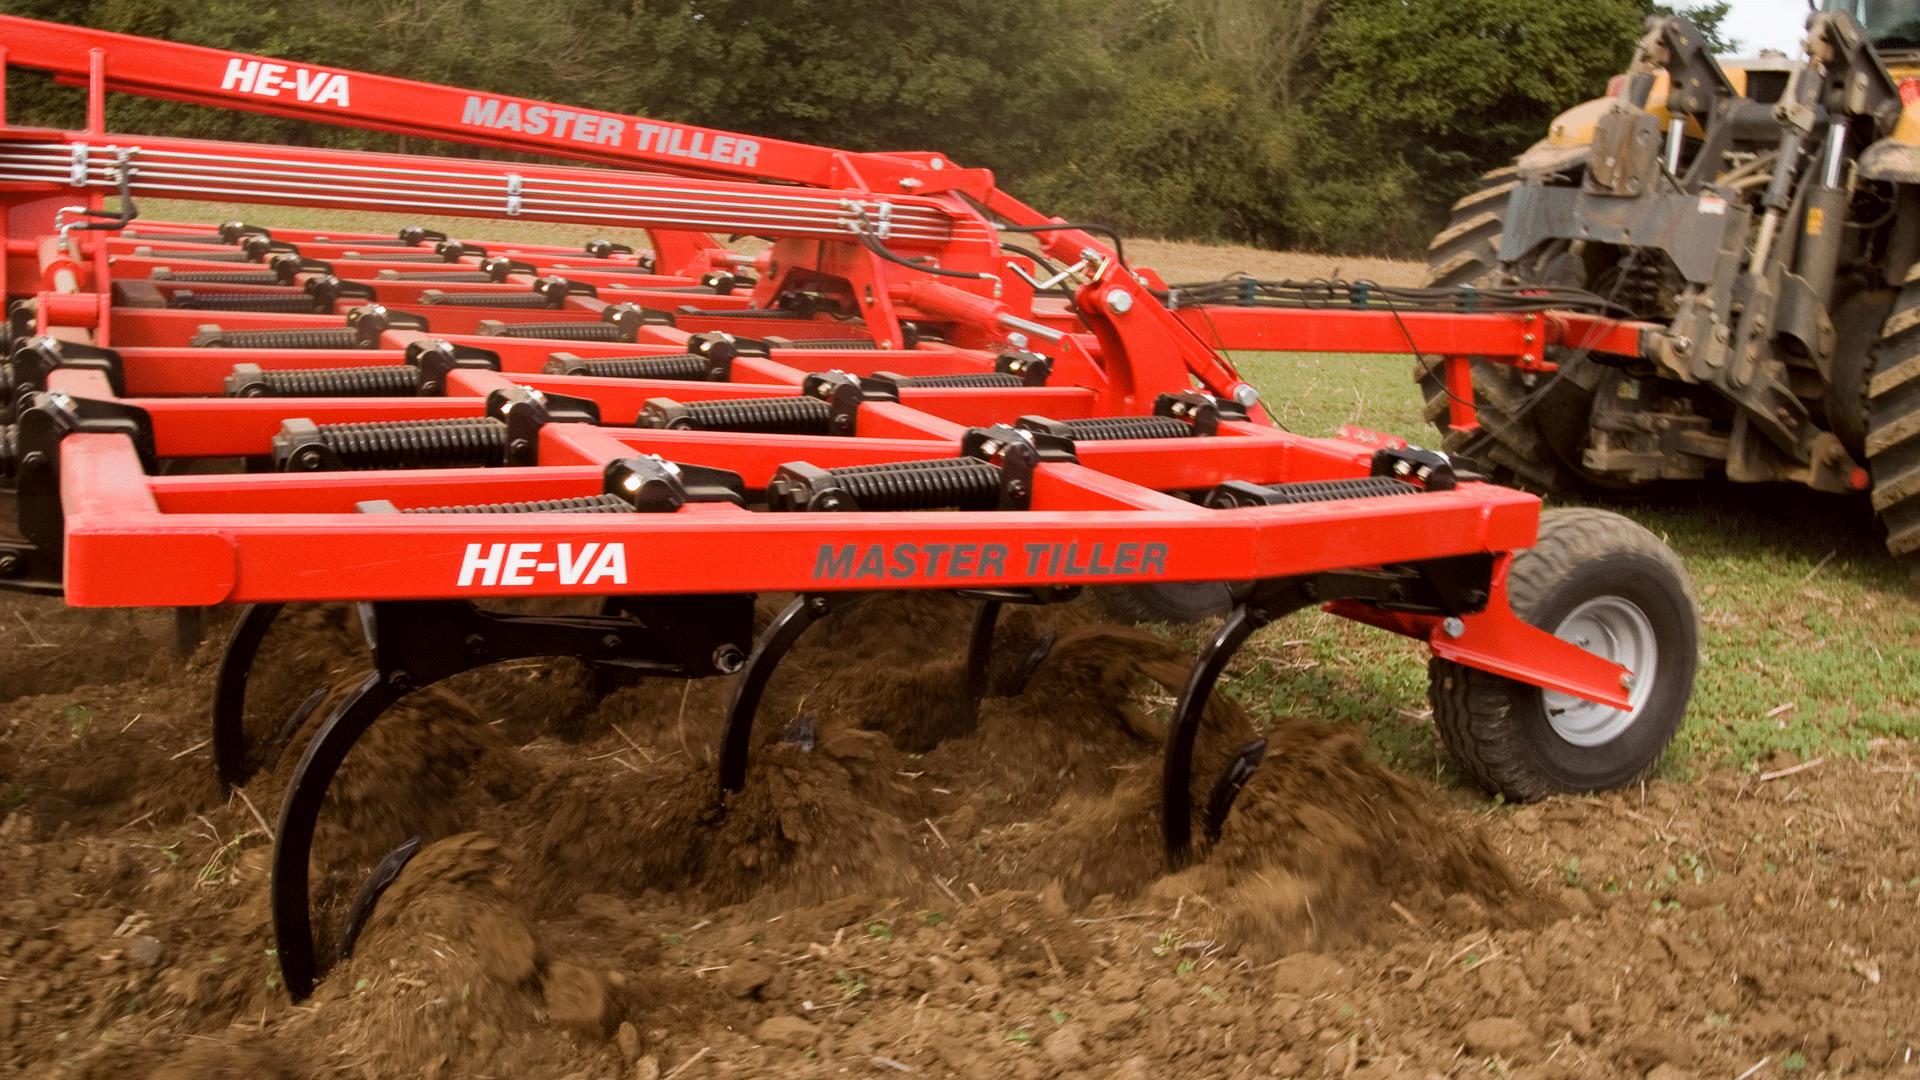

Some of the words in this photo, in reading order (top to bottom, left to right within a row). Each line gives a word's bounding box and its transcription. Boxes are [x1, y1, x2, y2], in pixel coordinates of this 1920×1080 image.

[222, 58, 350, 107] HE-VA
[462, 96, 624, 147] MASTER
[635, 122, 760, 167] TILLER
[457, 543, 627, 586] HE-VA
[813, 543, 1007, 580] MASTER
[1024, 542, 1168, 576] TILLER
